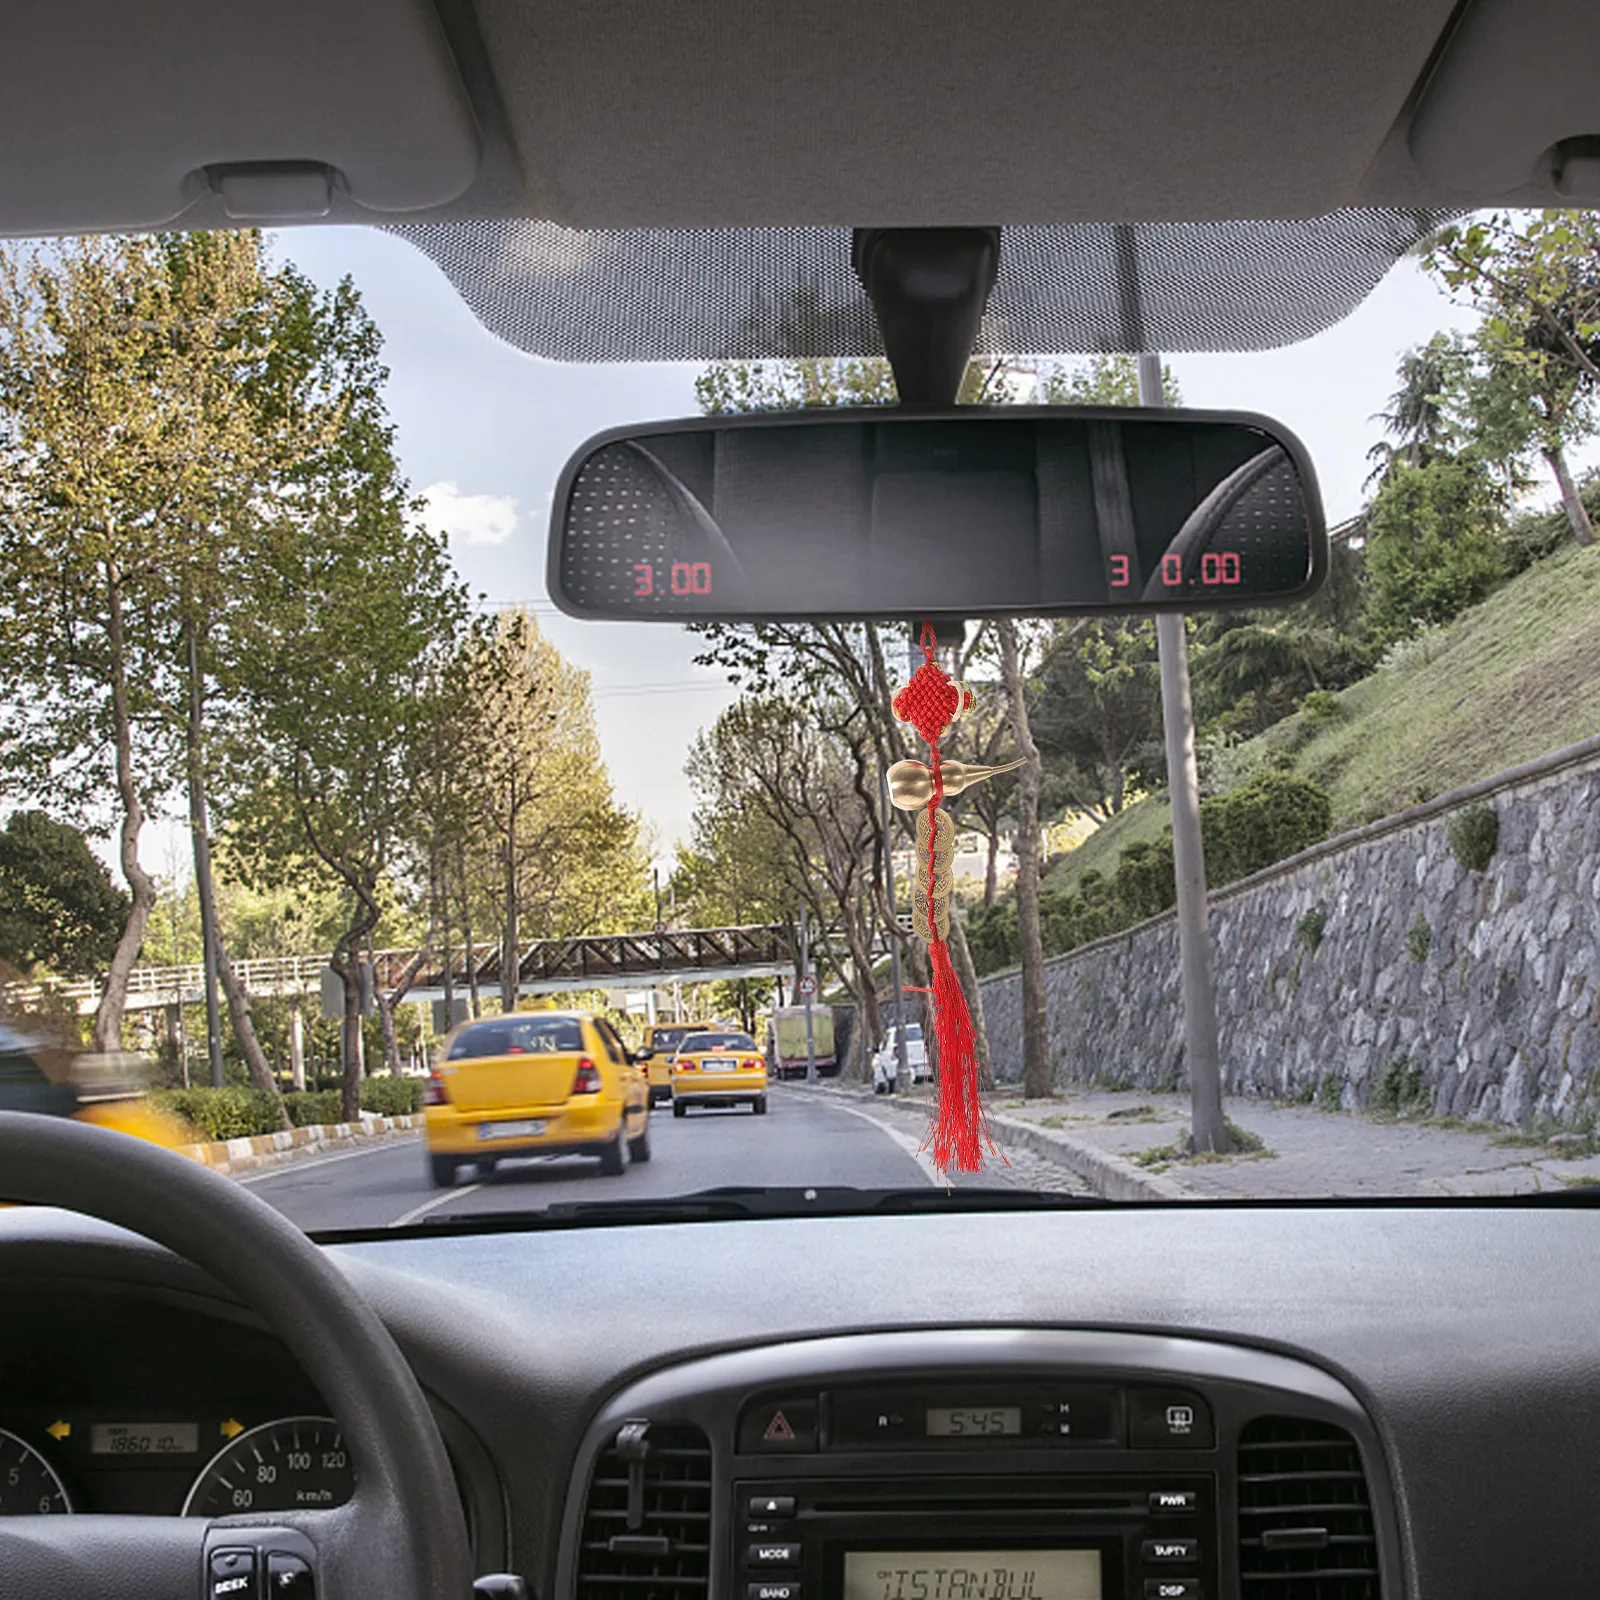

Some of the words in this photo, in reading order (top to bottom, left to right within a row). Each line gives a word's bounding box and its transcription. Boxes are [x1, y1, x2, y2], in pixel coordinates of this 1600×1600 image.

[633, 563, 711, 595] 3.00
[1110, 555, 1129, 586] 3
[1162, 553, 1240, 585] 0.00
[287, 1452, 311, 1470] 100
[321, 1452, 346, 1468] 120
[7, 1467, 19, 1487] 5
[256, 1465, 277, 1484] 80
[232, 1489, 253, 1508] 60
[296, 1488, 332, 1501] km/h
[759, 1587, 791, 1599] BAND
[891, 1569, 1043, 1600] ISTANBUL
